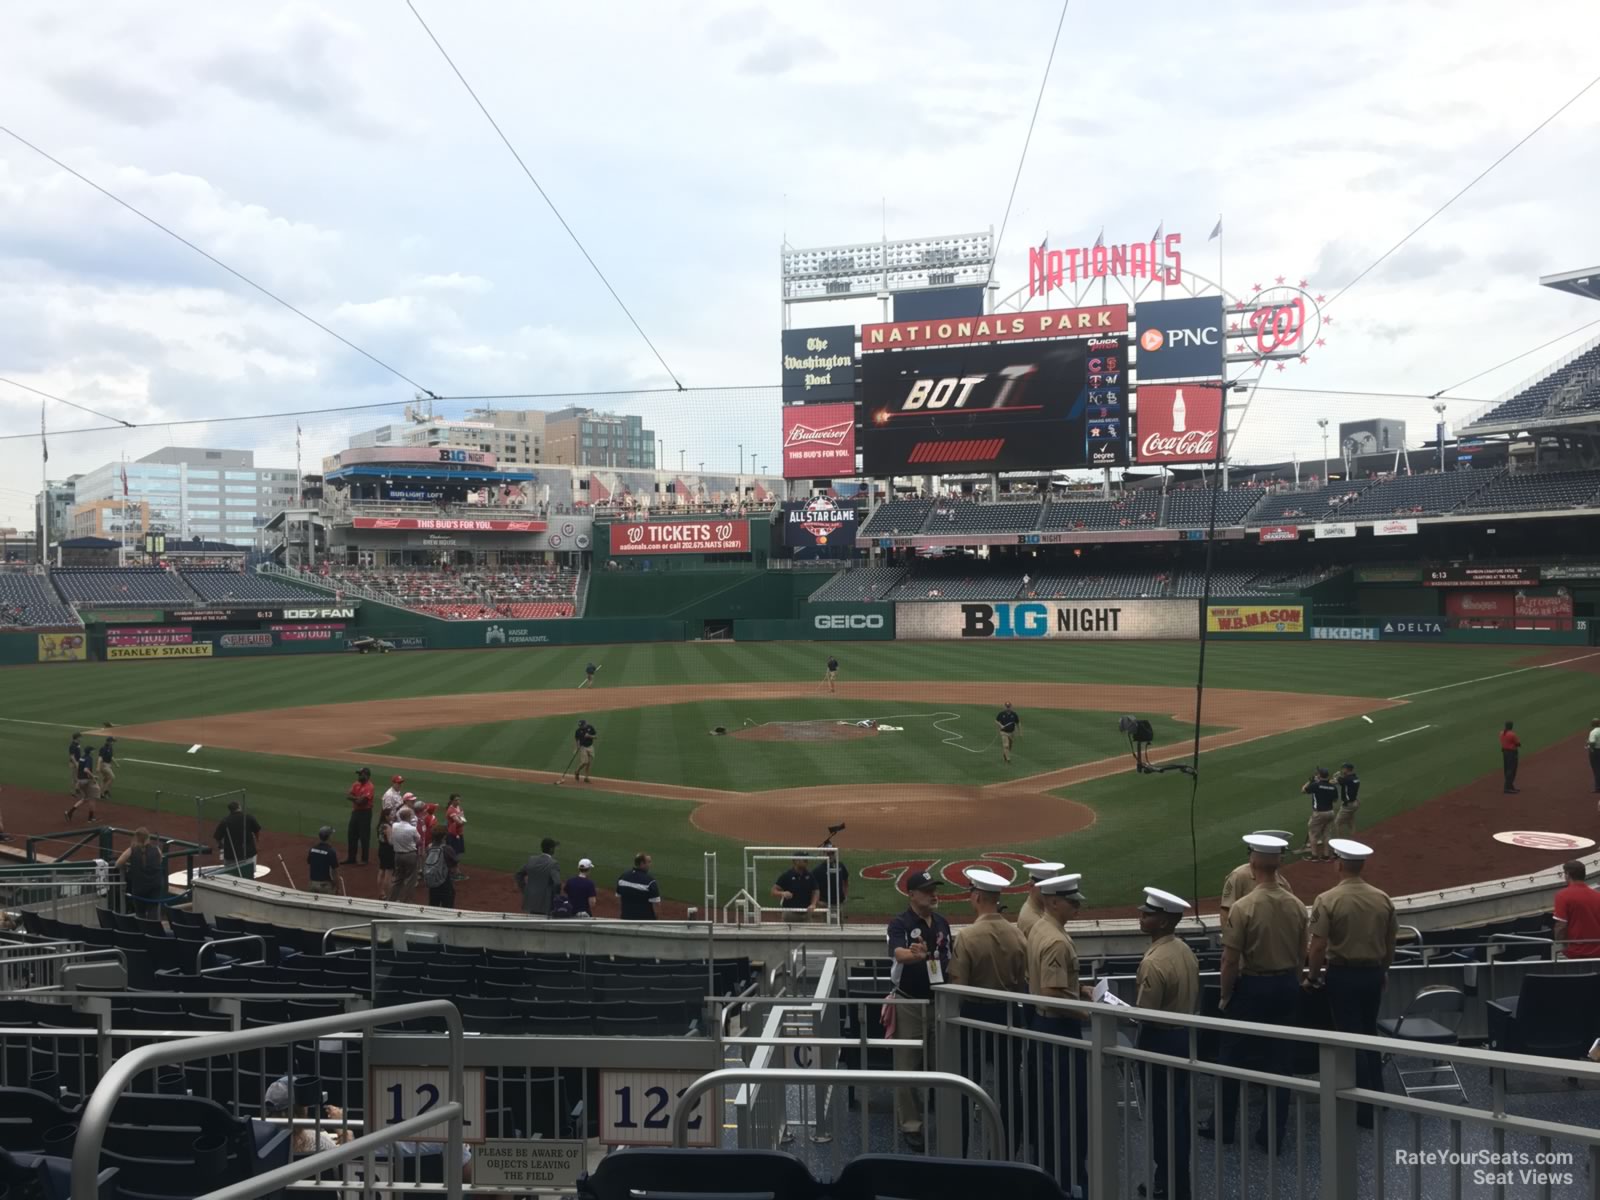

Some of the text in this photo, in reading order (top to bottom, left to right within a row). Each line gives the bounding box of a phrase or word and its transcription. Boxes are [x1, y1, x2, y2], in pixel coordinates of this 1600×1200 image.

[1029, 233, 1181, 297] NATIONALS
[871, 310, 1114, 343] NATIONALS PARK
[1167, 326, 1218, 348] PNC
[806, 337, 828, 352] The
[784, 354, 852, 371] Washington
[805, 373, 831, 390] Post
[901, 376, 986, 411] BOT
[789, 429, 847, 441] Budweiser
[1142, 430, 1217, 457] Coca-Cola
[468, 453, 485, 462] NIGHT
[789, 451, 802, 459] THIS
[803, 450, 822, 458] BUD'S
[789, 510, 855, 523] ALL STAR GAME
[416, 519, 435, 528] THIS
[436, 520, 459, 528] BUD'S
[460, 520, 474, 529] FOR
[648, 524, 711, 542] TICKETS
[1041, 534, 1062, 543] NIGHT
[619, 543, 661, 551] nationals.com
[669, 542, 681, 550] call
[321, 608, 354, 618] FAN
[1057, 607, 1122, 632] NIGHT
[814, 614, 884, 629] GEICO
[1397, 623, 1442, 633] DELTA
[1328, 627, 1376, 640] KOCH
[111, 646, 208, 658] STANLEY STANLEY
[478, 1148, 579, 1158] PLEASE BE AWARE OF
[487, 1159, 571, 1170] OBJECTS LEAVING
[504, 1171, 555, 1181] THE FIELD
